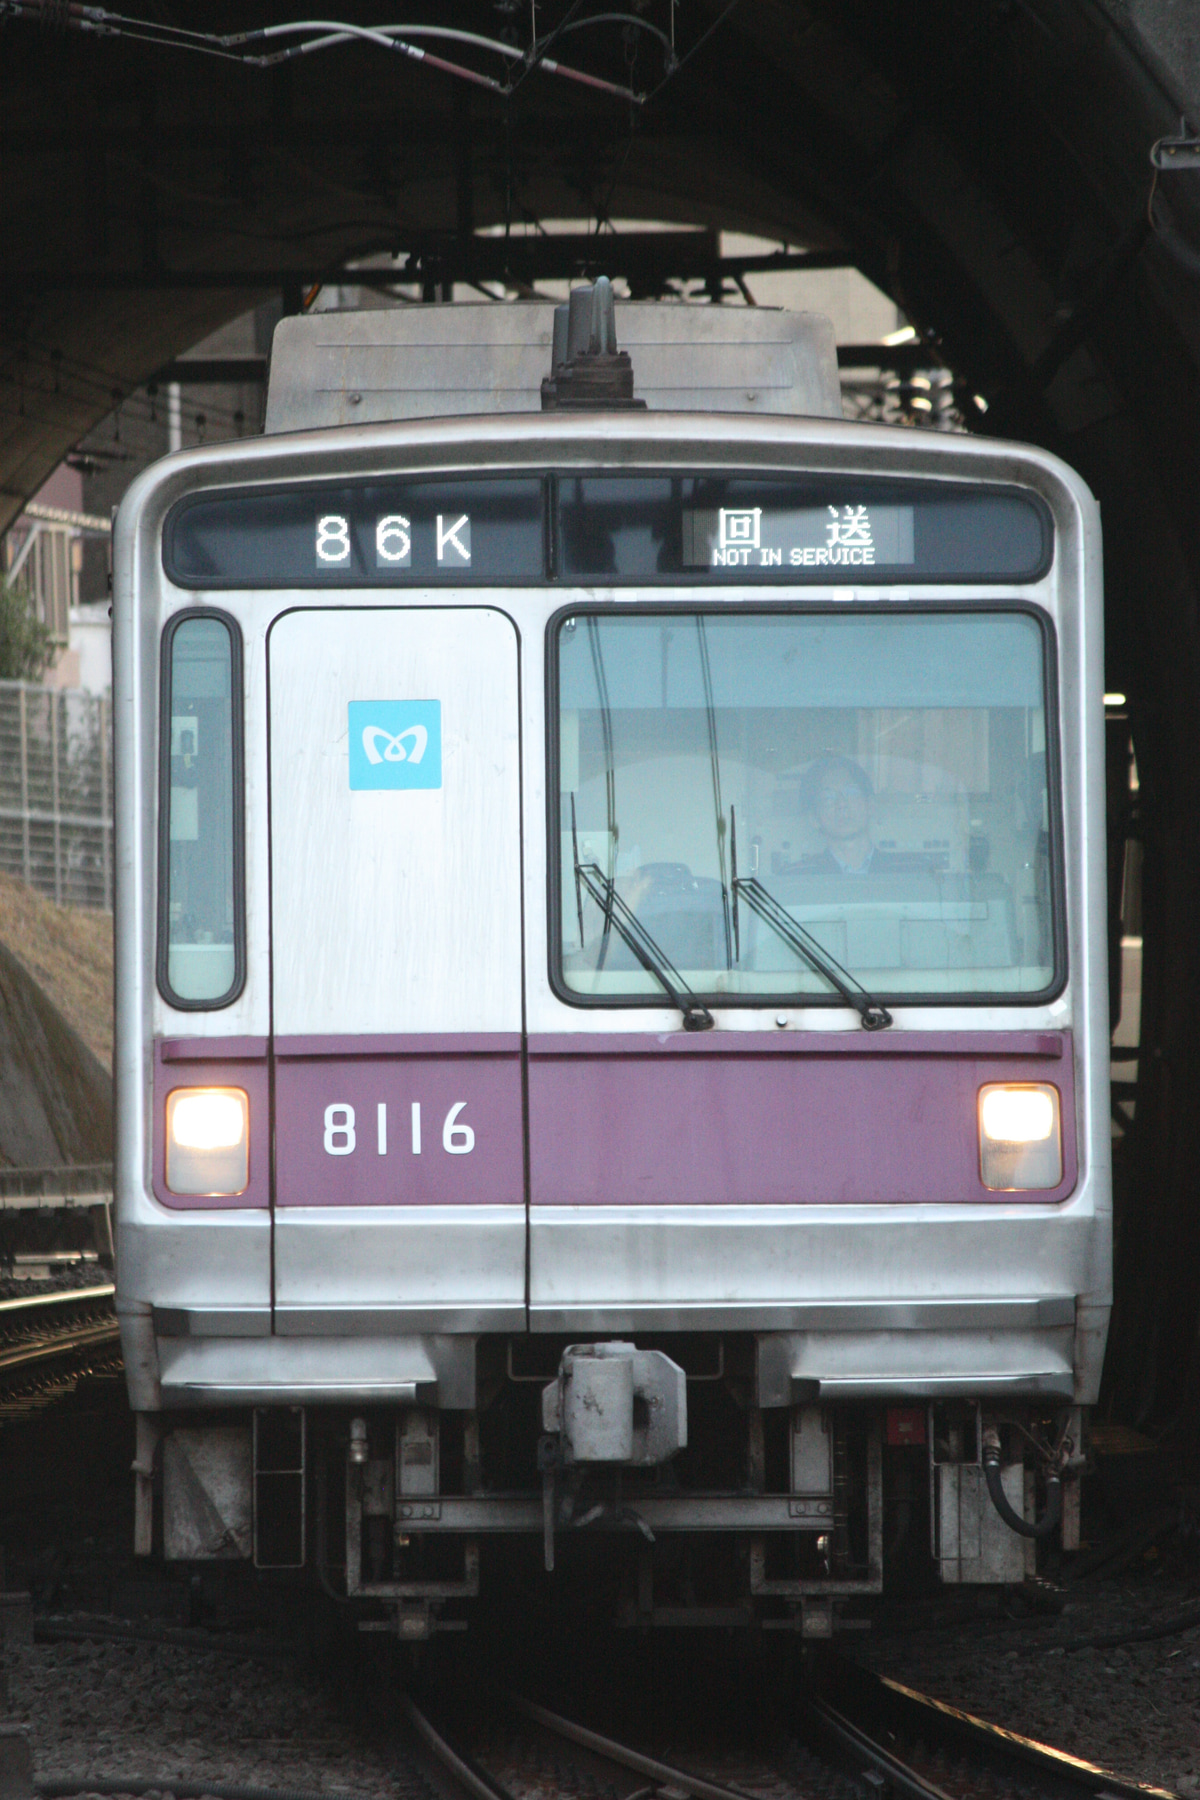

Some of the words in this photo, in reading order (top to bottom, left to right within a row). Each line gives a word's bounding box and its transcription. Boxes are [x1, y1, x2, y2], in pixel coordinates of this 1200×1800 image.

[719, 505, 874, 549] 回送
[712, 548, 752, 566] NOT
[760, 548, 782, 566] IN
[789, 548, 876, 565] SERVICE
[323, 1102, 475, 1156] 8116
